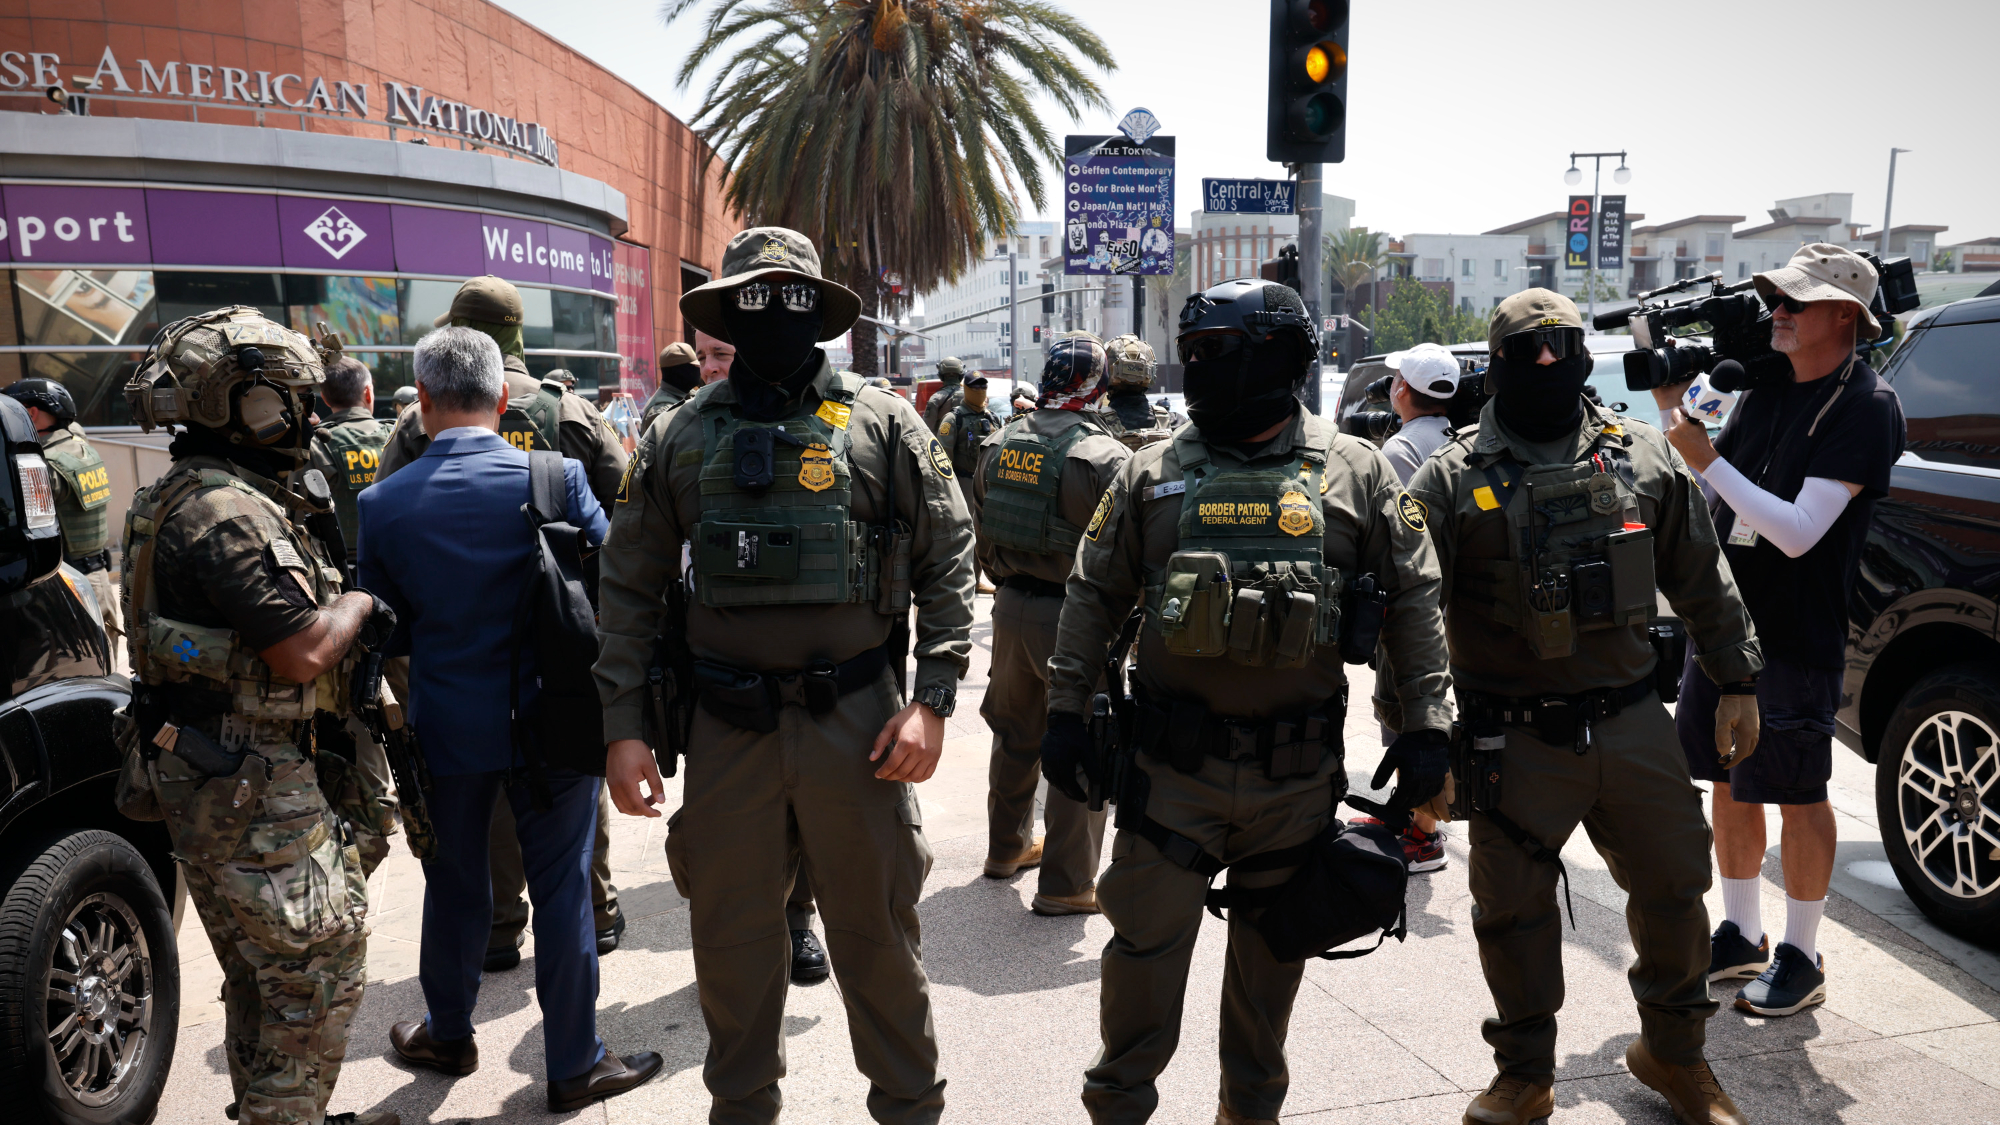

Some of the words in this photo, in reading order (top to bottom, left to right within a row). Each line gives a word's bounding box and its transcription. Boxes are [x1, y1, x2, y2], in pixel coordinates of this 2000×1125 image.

[85, 44, 369, 118] AMERICAN
[382, 81, 533, 151] NATIONAL
[1122, 146, 1153, 156] TOKYO
[1082, 166, 1110, 175] Geffen
[1112, 166, 1173, 177] Contemporary
[1081, 184, 1093, 193] Go
[1095, 184, 1108, 193] for
[1111, 184, 1135, 193] Broke
[1138, 184, 1162, 193] Mon't
[1209, 181, 1261, 199] Central
[1273, 182, 1290, 199] Av
[1081, 201, 1124, 212] Japan/Am
[1149, 202, 1167, 211] Mus
[1210, 199, 1226, 211] 100
[1230, 199, 1237, 211] S
[1087, 220, 1108, 229] onda
[1110, 220, 1133, 229] Plaza
[0, 211, 135, 257] port
[482, 226, 585, 273] Welcome
[590, 251, 601, 277] to
[602, 249, 613, 280] Li
[620, 294, 638, 316] 2026
[1540, 318, 1560, 326] CAX
[1688, 385, 1701, 402] 4
[1698, 398, 1722, 415] 4
[498, 431, 535, 453] ICE
[345, 448, 382, 470] POL
[999, 448, 1045, 473] POLICE
[78, 466, 109, 492] POLICE
[350, 473, 364, 484] U.S.
[1005, 470, 1022, 482] BORDER
[1022, 472, 1039, 485] PATROL
[1198, 502, 1235, 516] BORDER
[1237, 502, 1272, 516] PATROL
[1202, 516, 1239, 525] FEDERAL
[1239, 516, 1268, 525] AGENT
